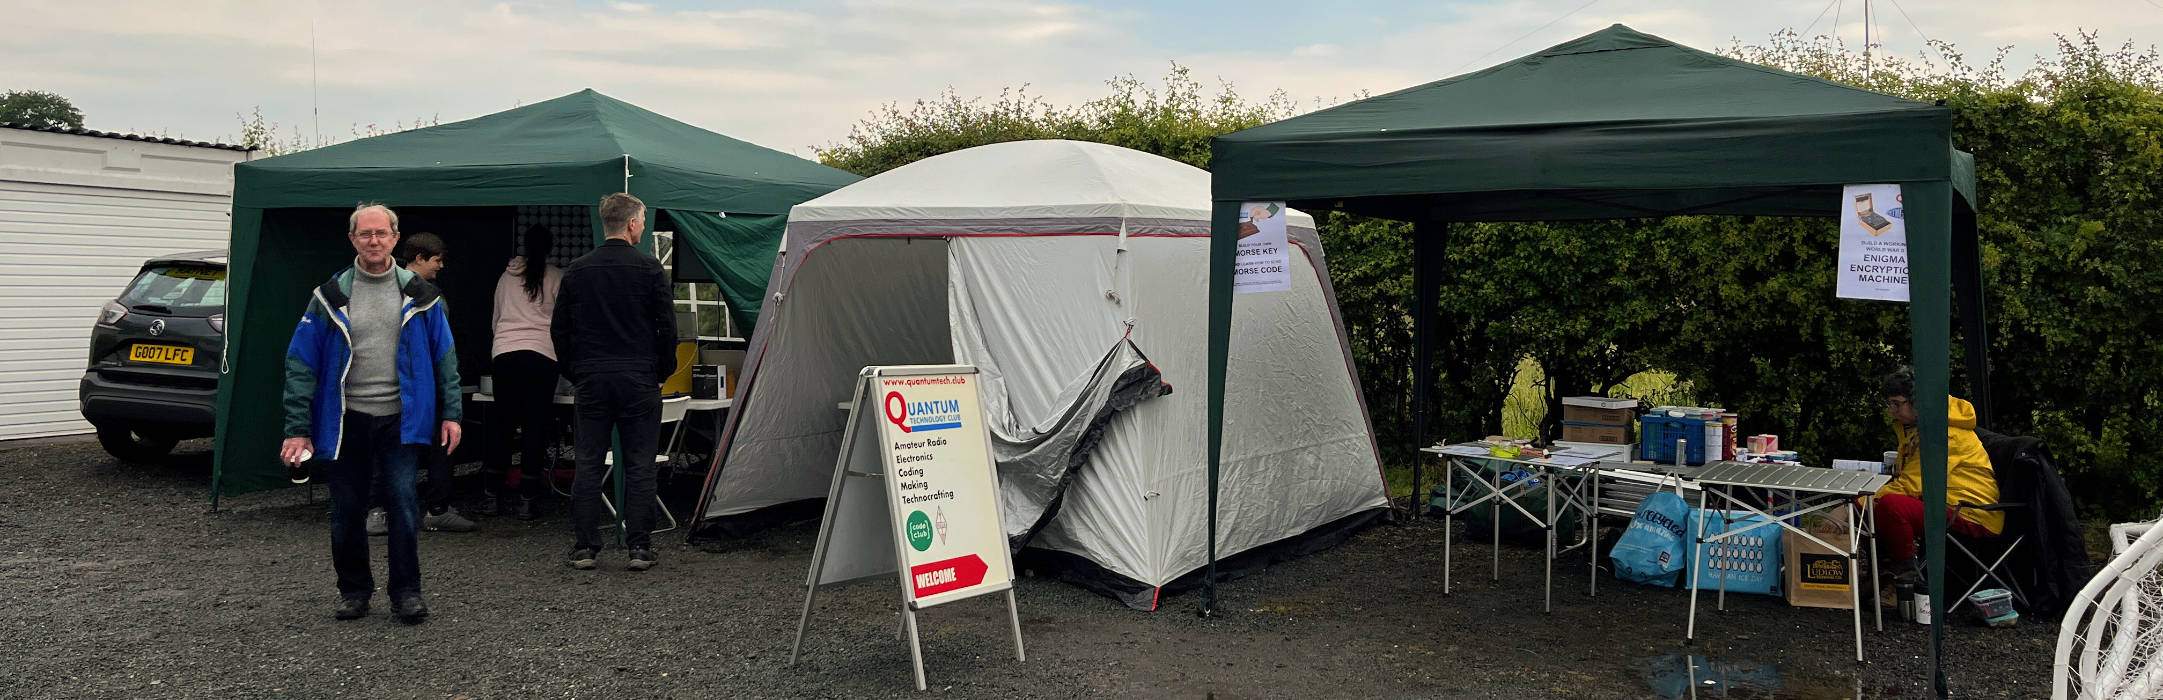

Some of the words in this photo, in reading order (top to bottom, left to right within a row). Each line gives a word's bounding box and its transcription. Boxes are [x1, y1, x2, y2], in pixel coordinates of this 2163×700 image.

[1262, 247, 1278, 255] KEY
[1863, 254, 1906, 264] ENIGMA
[1260, 266, 1283, 274] CODE
[1850, 264, 1909, 275] ENCRYPTIO
[1858, 274, 1909, 285] MACHINE
[164, 347, 189, 361] LFC
[883, 376, 966, 387] www.quantumtech.club
[885, 390, 960, 433] QUANTUM
[910, 416, 946, 424] TECHNOLOGY
[895, 441, 926, 450] Amateur
[926, 437, 947, 447] Radio
[896, 452, 934, 463] Electronics
[898, 467, 924, 477] Coding
[901, 480, 928, 490] Making
[902, 490, 954, 504] Technocrafting
[913, 530, 928, 539] club
[915, 567, 957, 589] WELCOME
